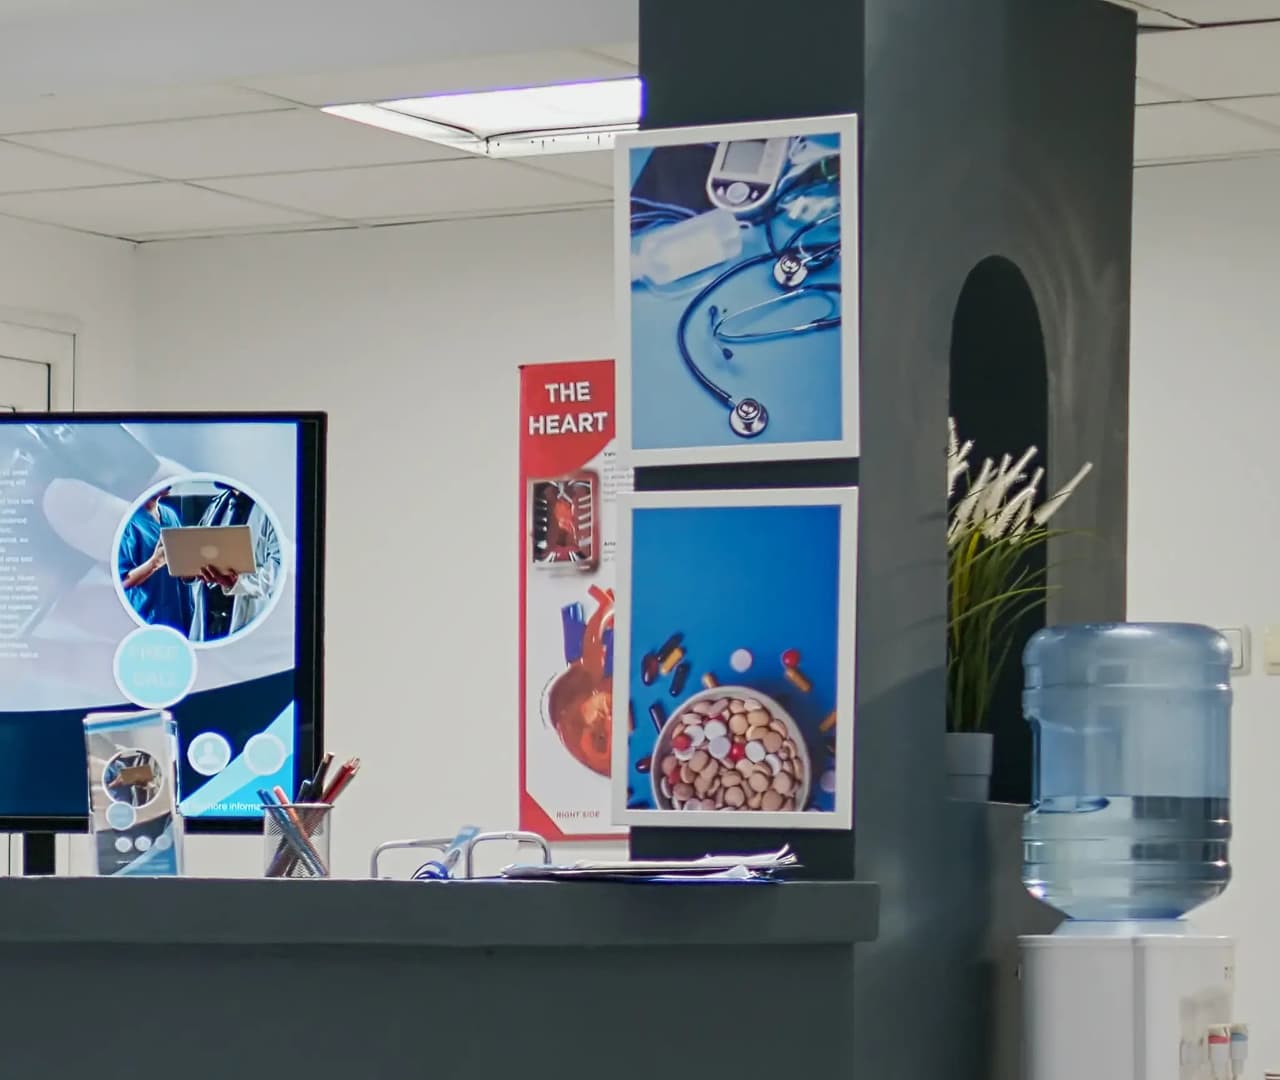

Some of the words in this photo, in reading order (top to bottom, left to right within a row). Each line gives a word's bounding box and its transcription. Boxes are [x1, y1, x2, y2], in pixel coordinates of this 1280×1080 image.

[544, 381, 591, 403] THE
[528, 411, 608, 436] HEART
[229, 801, 264, 811] informa
[556, 811, 580, 819] RIGHT
[582, 810, 600, 818] SIDE
